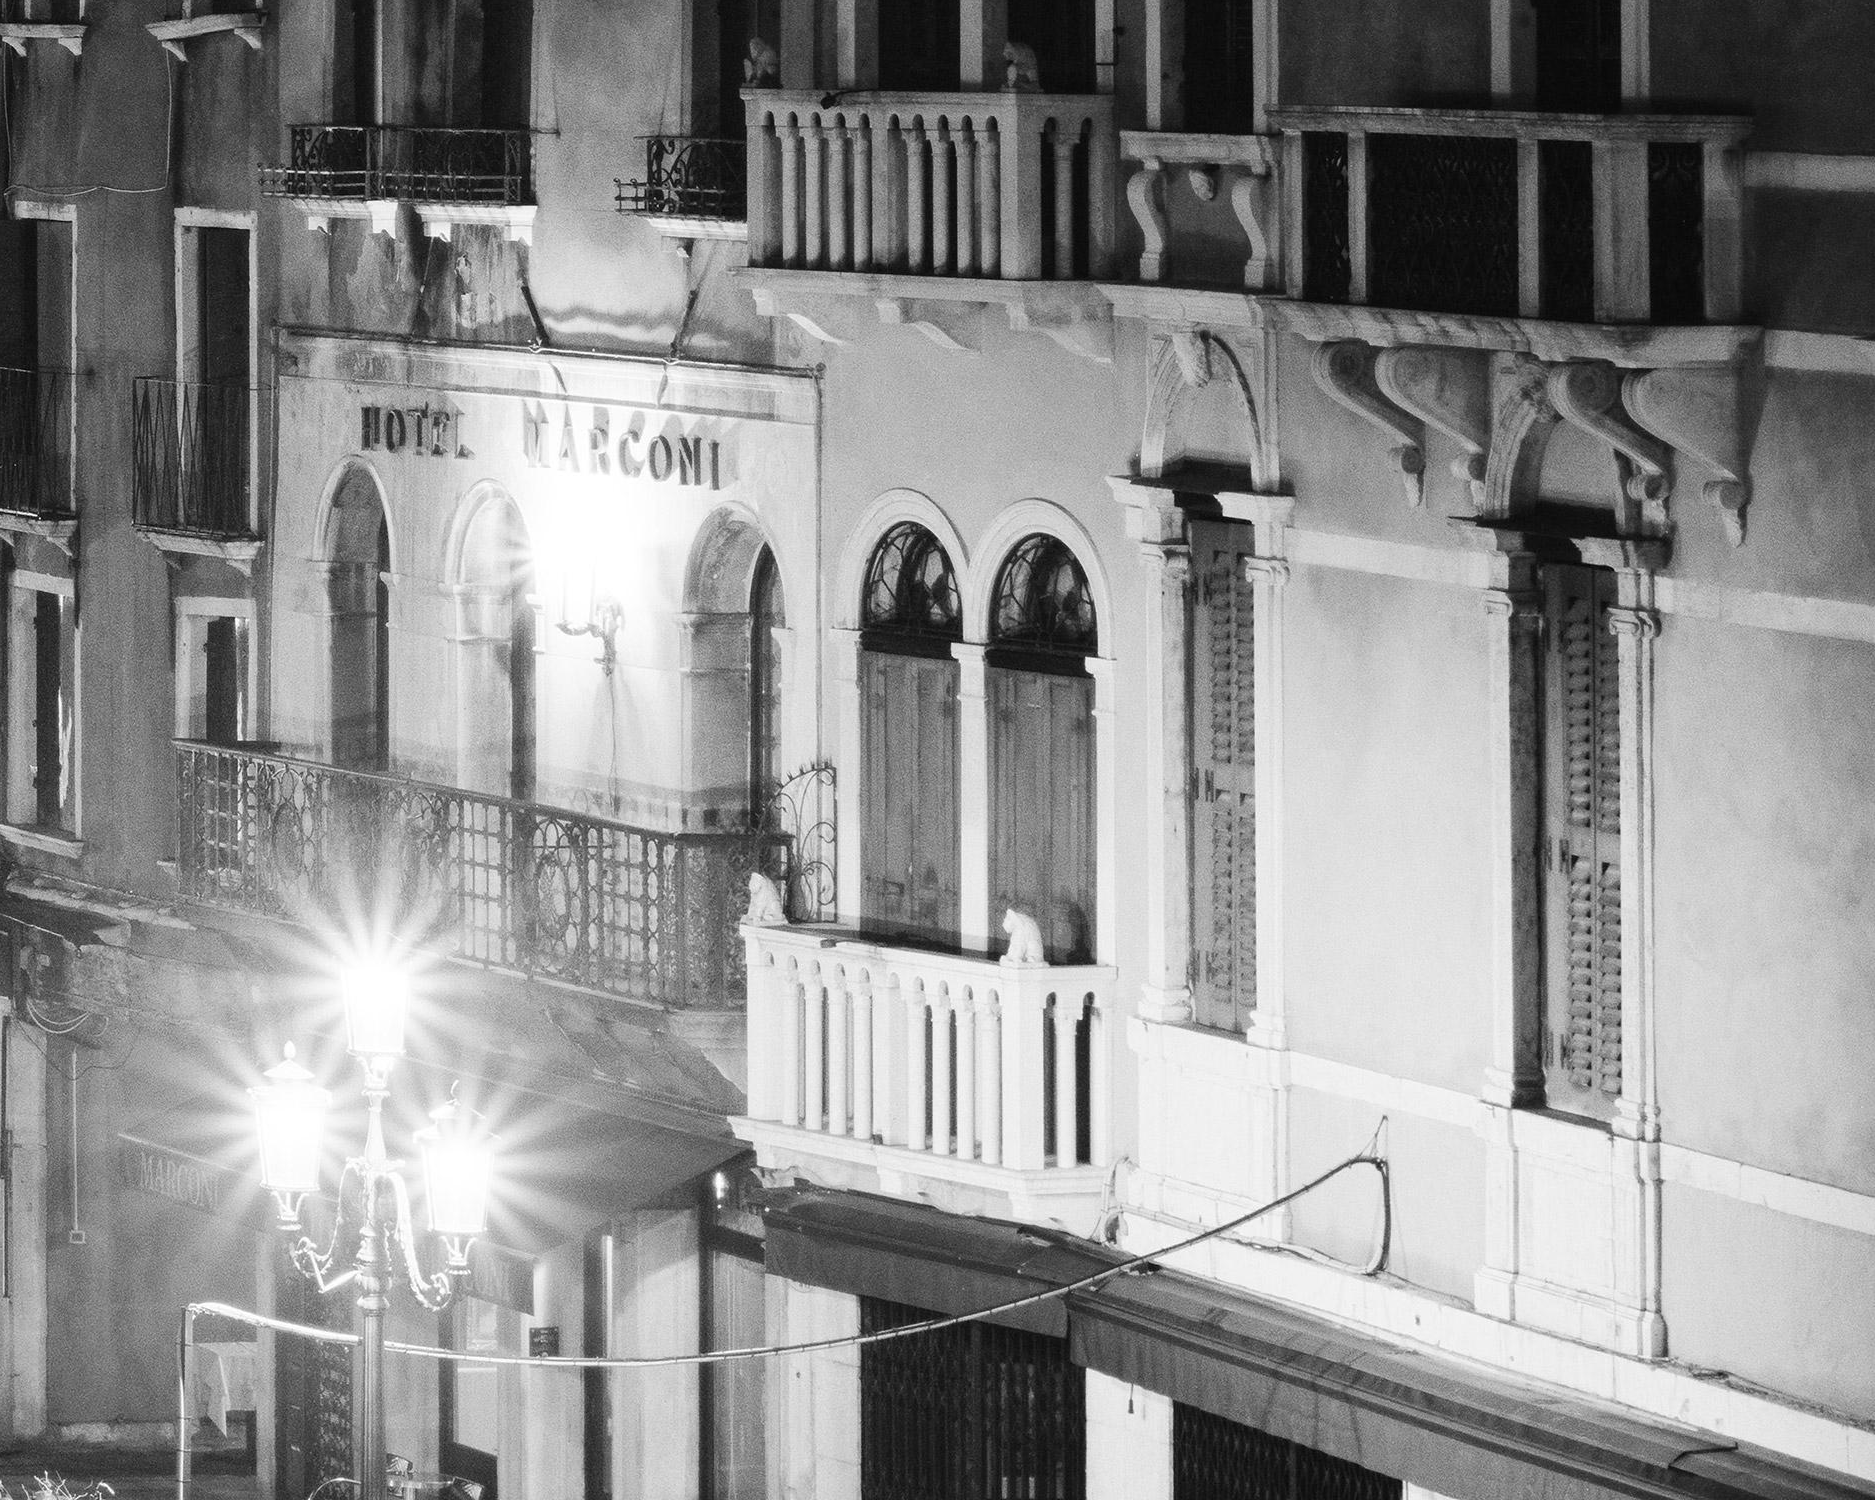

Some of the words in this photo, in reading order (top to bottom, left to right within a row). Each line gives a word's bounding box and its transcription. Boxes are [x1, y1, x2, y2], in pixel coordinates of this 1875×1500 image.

[361, 405, 472, 458] HOTEL
[525, 415, 721, 490] MARCONI
[140, 1151, 219, 1208] MARCONI
